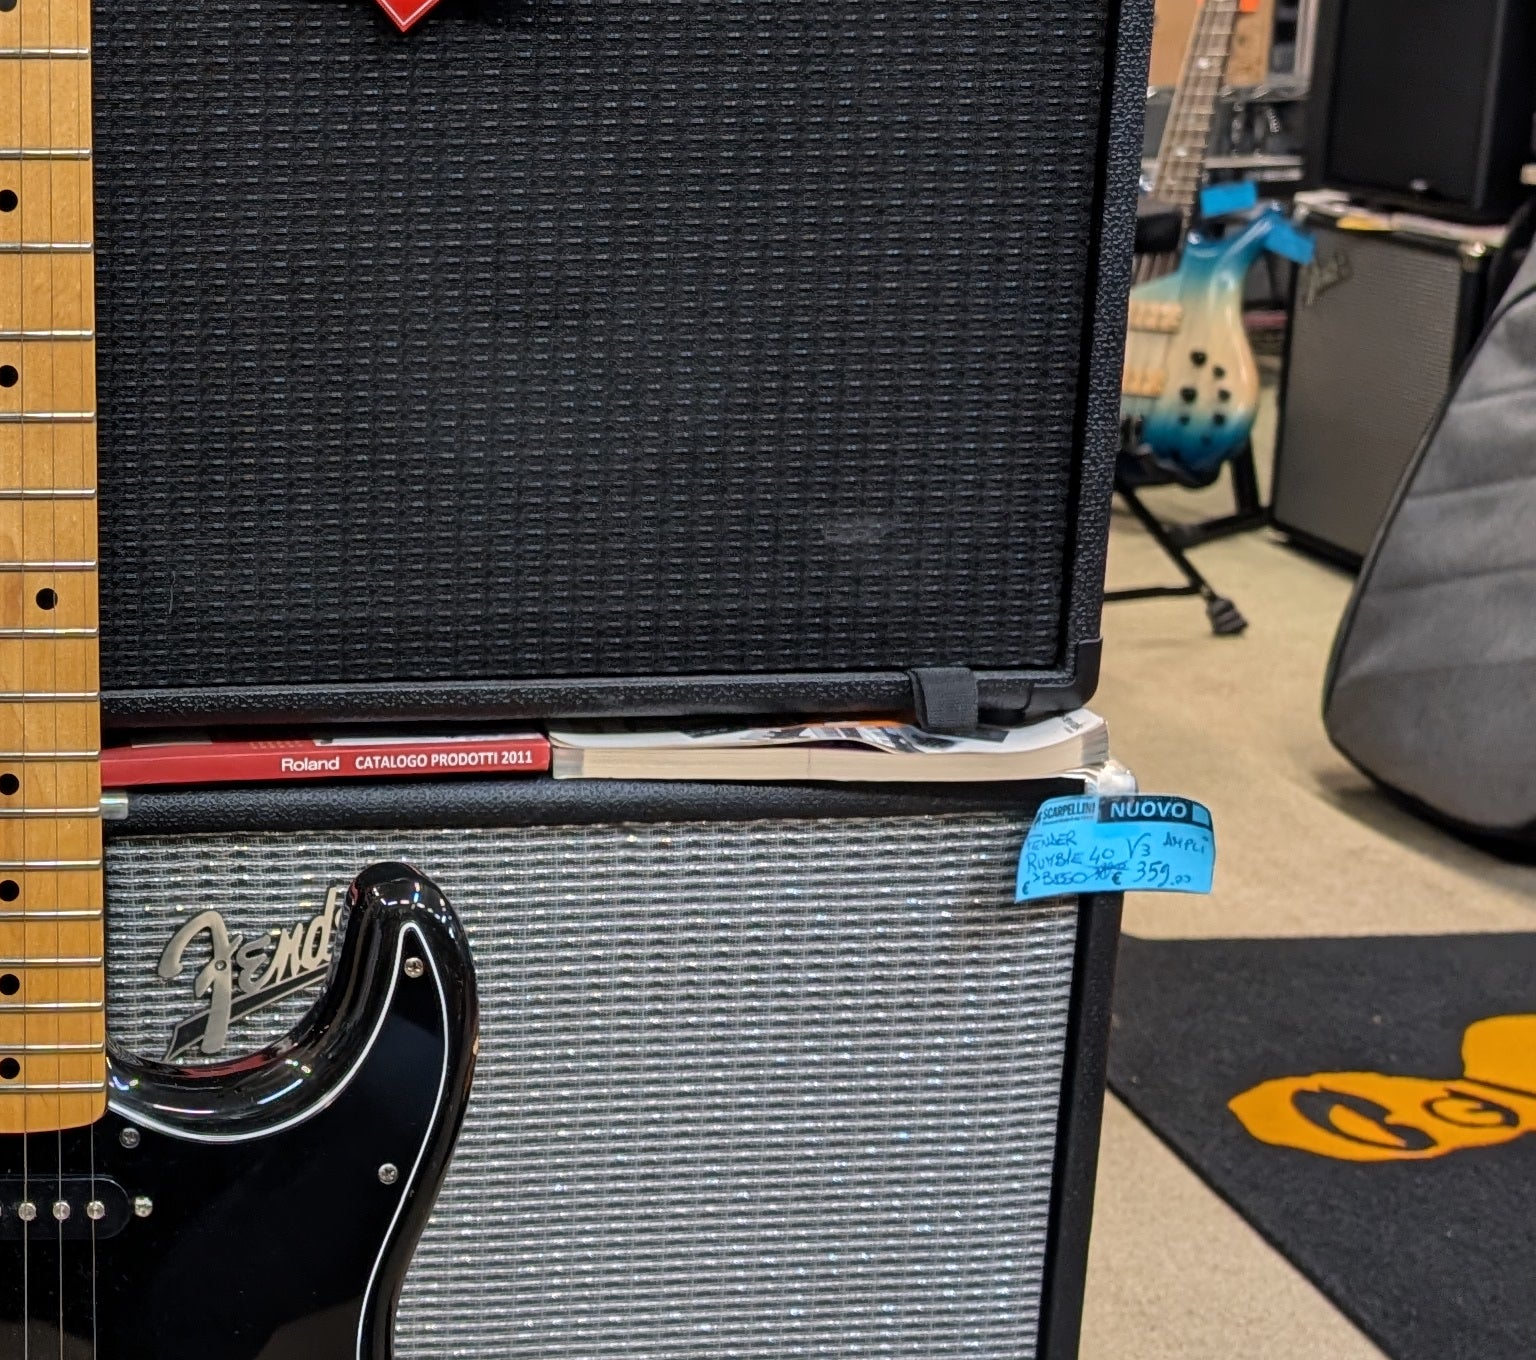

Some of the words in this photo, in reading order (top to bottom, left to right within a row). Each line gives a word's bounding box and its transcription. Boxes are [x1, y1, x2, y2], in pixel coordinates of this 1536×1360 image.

[281, 755, 340, 772] Roland
[354, 753, 429, 770] CATALOGO
[430, 751, 500, 768] PRODOTTI
[501, 749, 533, 766] 2011
[1042, 802, 1096, 820] SCARPELLINI
[1109, 801, 1188, 819] NUOVO
[1089, 846, 1115, 864] 40
[158, 885, 347, 1054] Fend
